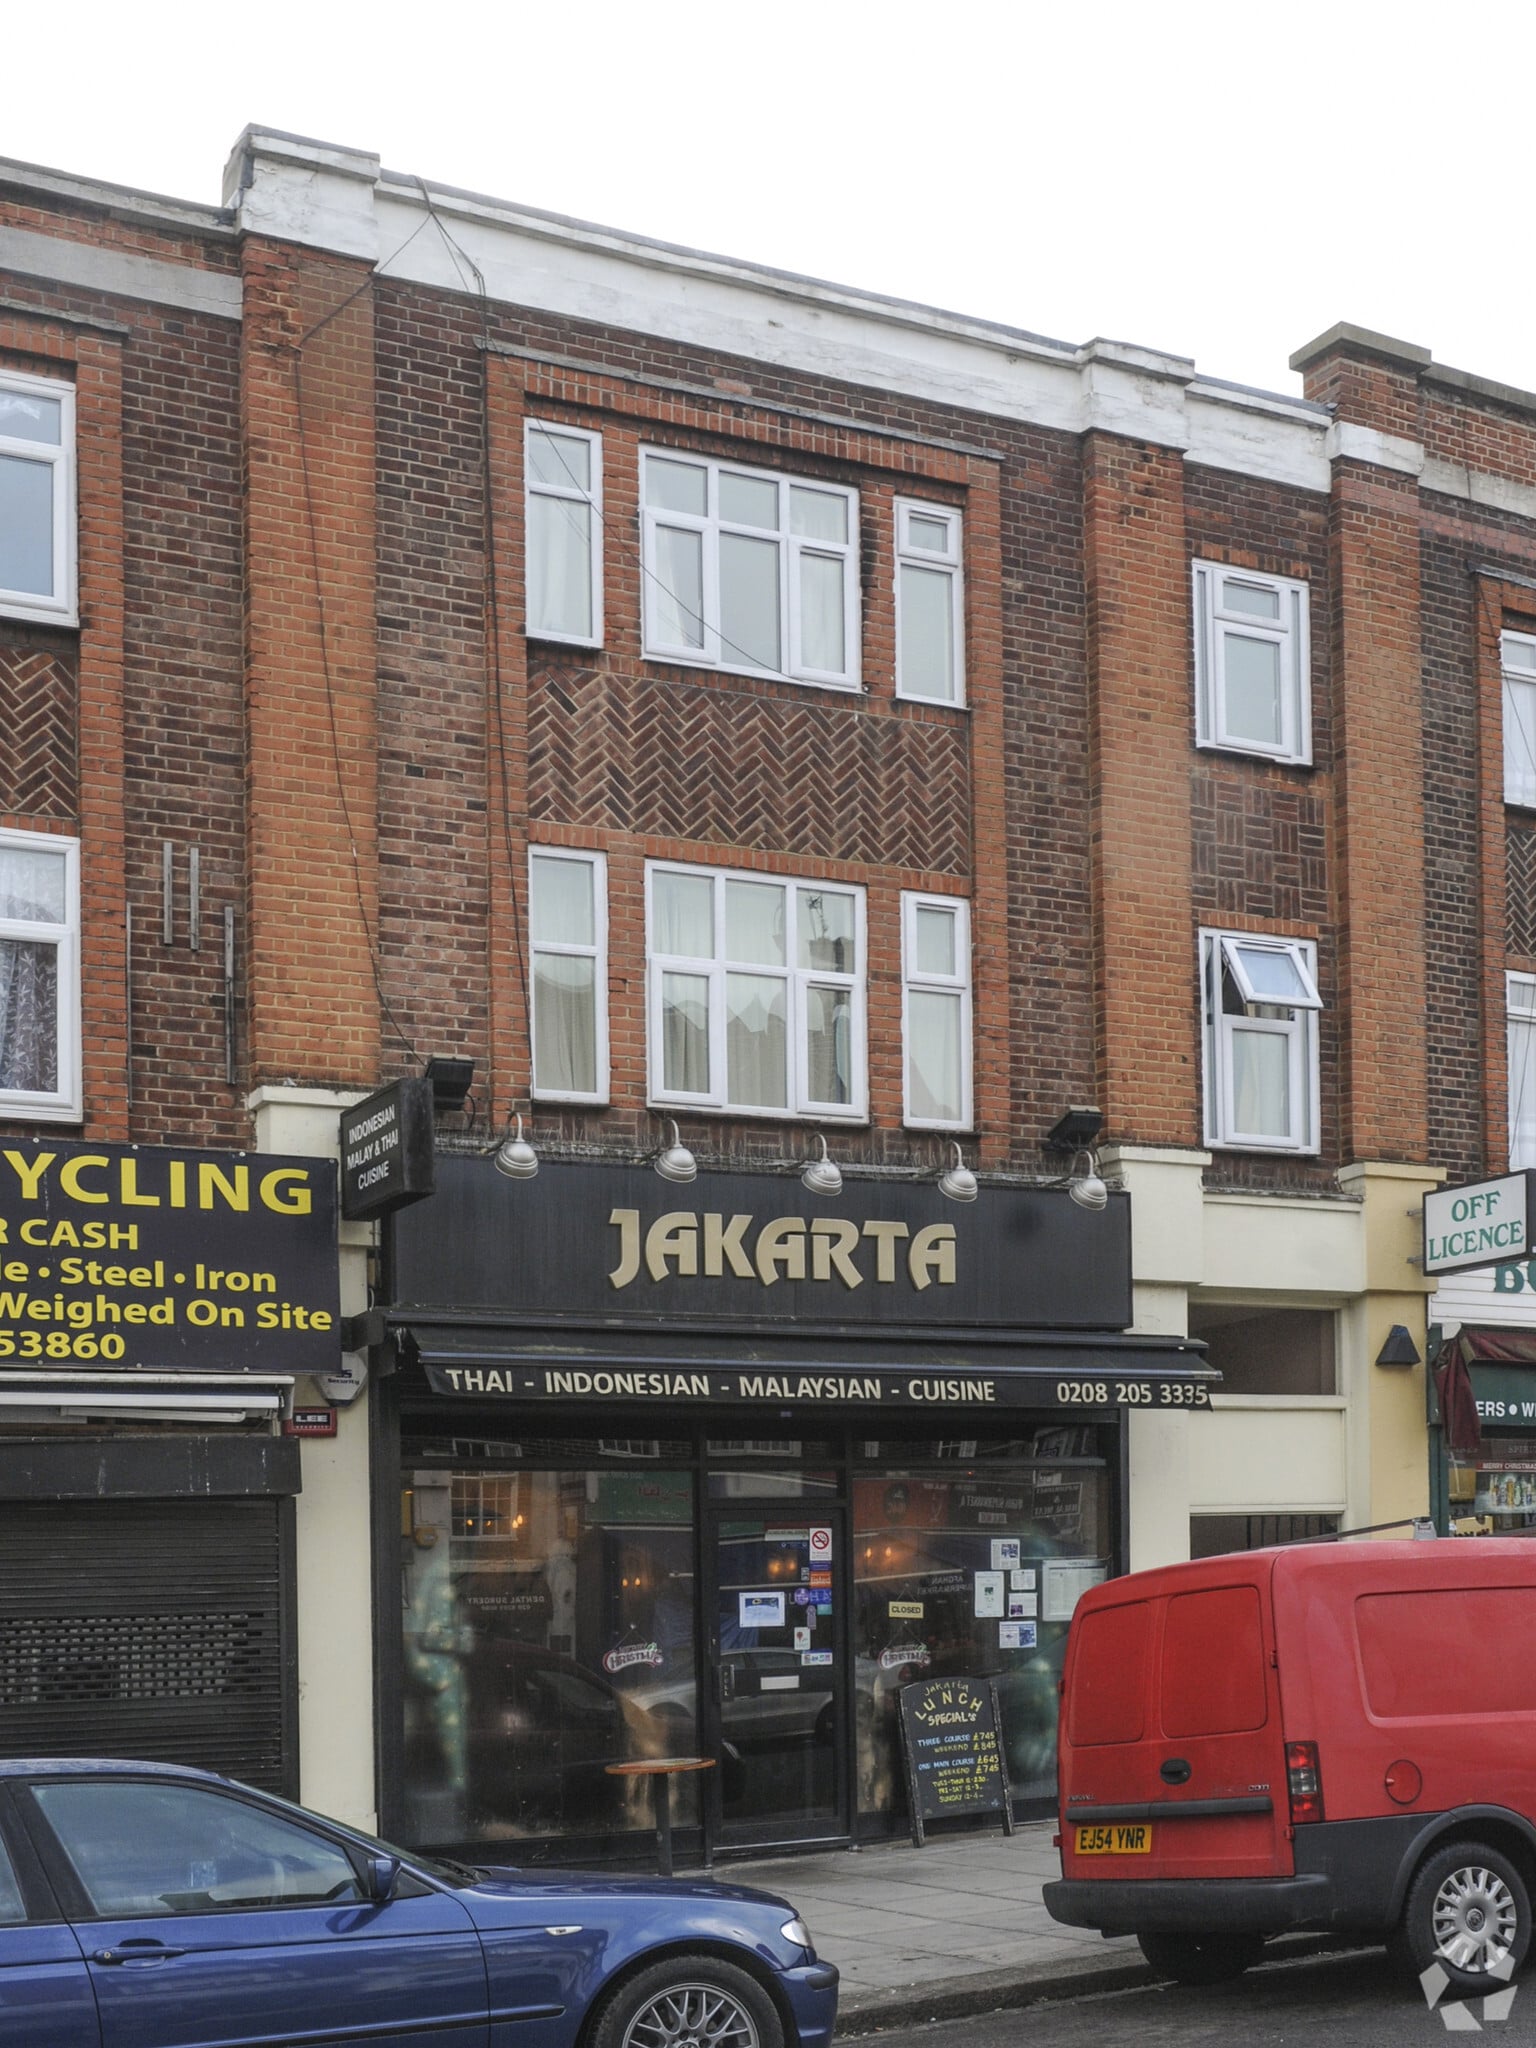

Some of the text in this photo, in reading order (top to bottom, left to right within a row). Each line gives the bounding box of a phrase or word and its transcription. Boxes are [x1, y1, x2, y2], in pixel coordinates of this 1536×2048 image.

[348, 1103, 395, 1145] INDONESIAN
[347, 1128, 399, 1171] MALAY & THAI
[3, 1150, 312, 1215] YCLING
[358, 1160, 390, 1190] CUISINE
[1451, 1190, 1501, 1222] OFF
[20, 1218, 139, 1250] CASH
[608, 1208, 957, 1291] JAKARTA
[1428, 1220, 1524, 1261] LICENCE
[0, 1253, 277, 1293] e Steel Iron
[0, 1291, 332, 1331] Weighed On Site
[0, 1331, 125, 1360] 53860
[445, 1368, 513, 1393] THAI
[545, 1371, 710, 1396] INDONESIAN
[739, 1376, 881, 1399] MALAYSIAN
[908, 1379, 995, 1401] CUISINE
[1056, 1382, 1108, 1403] 0208
[1115, 1383, 1152, 1403] 205
[1159, 1384, 1208, 1404] 3335
[891, 1606, 921, 1614] CLOSED
[915, 1690, 982, 1720] LUNCH
[917, 1737, 940, 1747] THREE
[944, 1734, 970, 1743] COURSE
[934, 1744, 968, 1753] WEEKEND
[918, 1762, 931, 1770] ONE
[933, 1760, 949, 1769] MAIN
[951, 1757, 975, 1767] COURSE
[938, 1768, 970, 1777] WEEKEND
[939, 1794, 962, 1803] SUNDAY
[1080, 1827, 1145, 1850] EJ54 YNR
